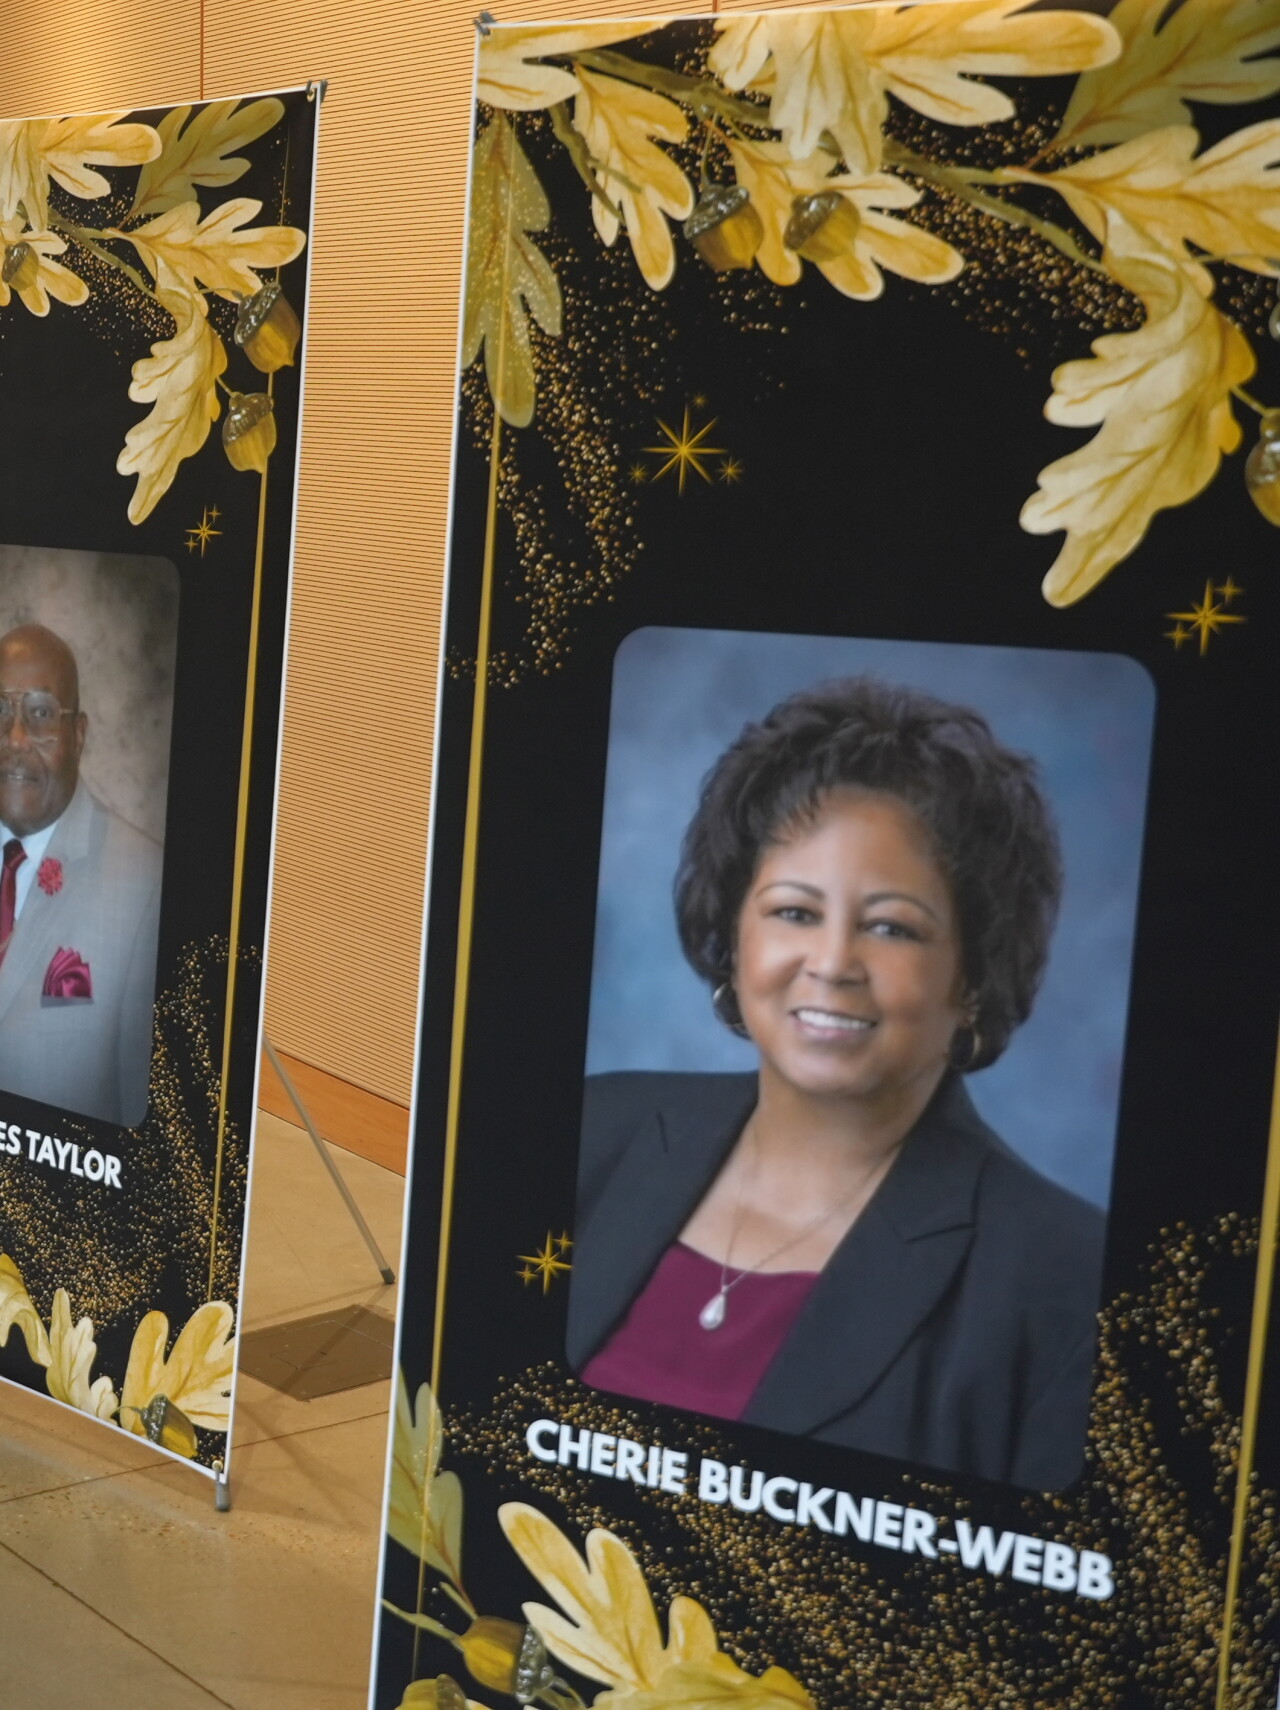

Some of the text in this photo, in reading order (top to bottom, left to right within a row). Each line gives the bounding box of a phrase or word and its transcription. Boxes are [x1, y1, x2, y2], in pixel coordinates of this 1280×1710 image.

[25, 1129, 122, 1189] TAYLOR
[525, 1418, 1116, 1601] CHERIE BUCKNER-WEBB
